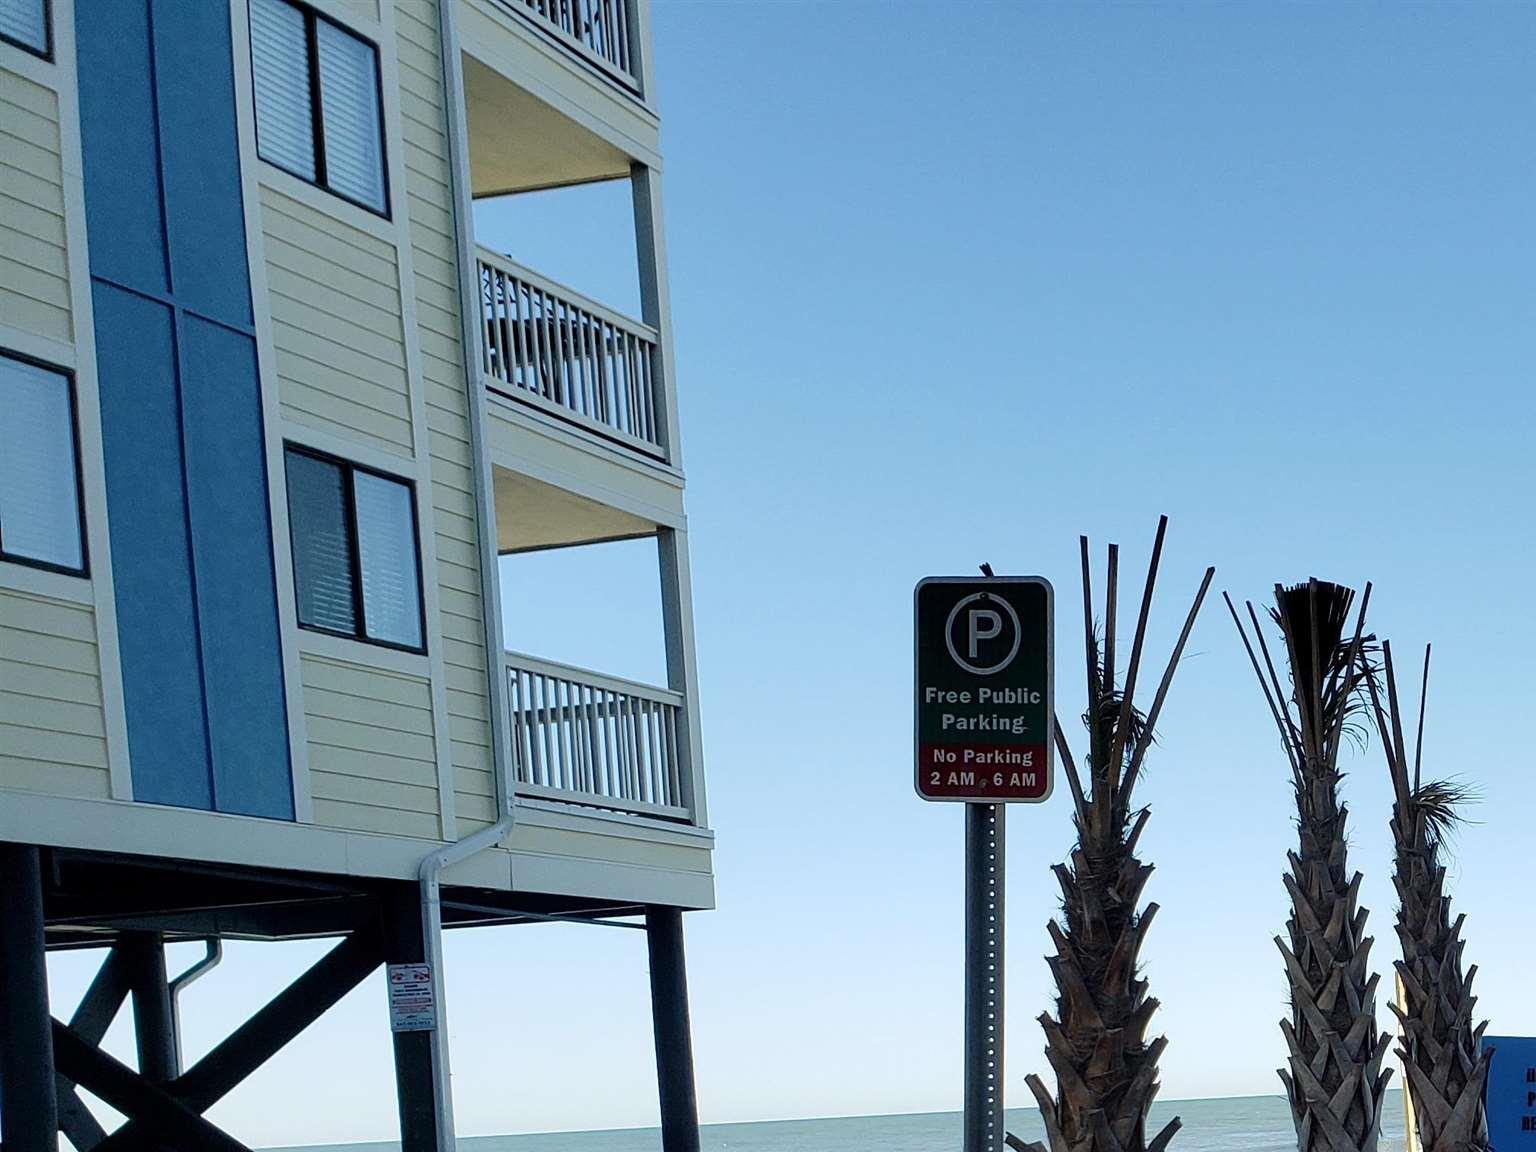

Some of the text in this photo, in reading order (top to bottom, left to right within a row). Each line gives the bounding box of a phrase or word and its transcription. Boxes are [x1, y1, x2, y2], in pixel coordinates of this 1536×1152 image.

[969, 609, 1002, 658] P
[925, 687, 1041, 704] Free Public
[942, 714, 1024, 734] Parking
[933, 749, 1033, 767] No Parking
[930, 771, 1036, 787] 2 AM 6 AM
